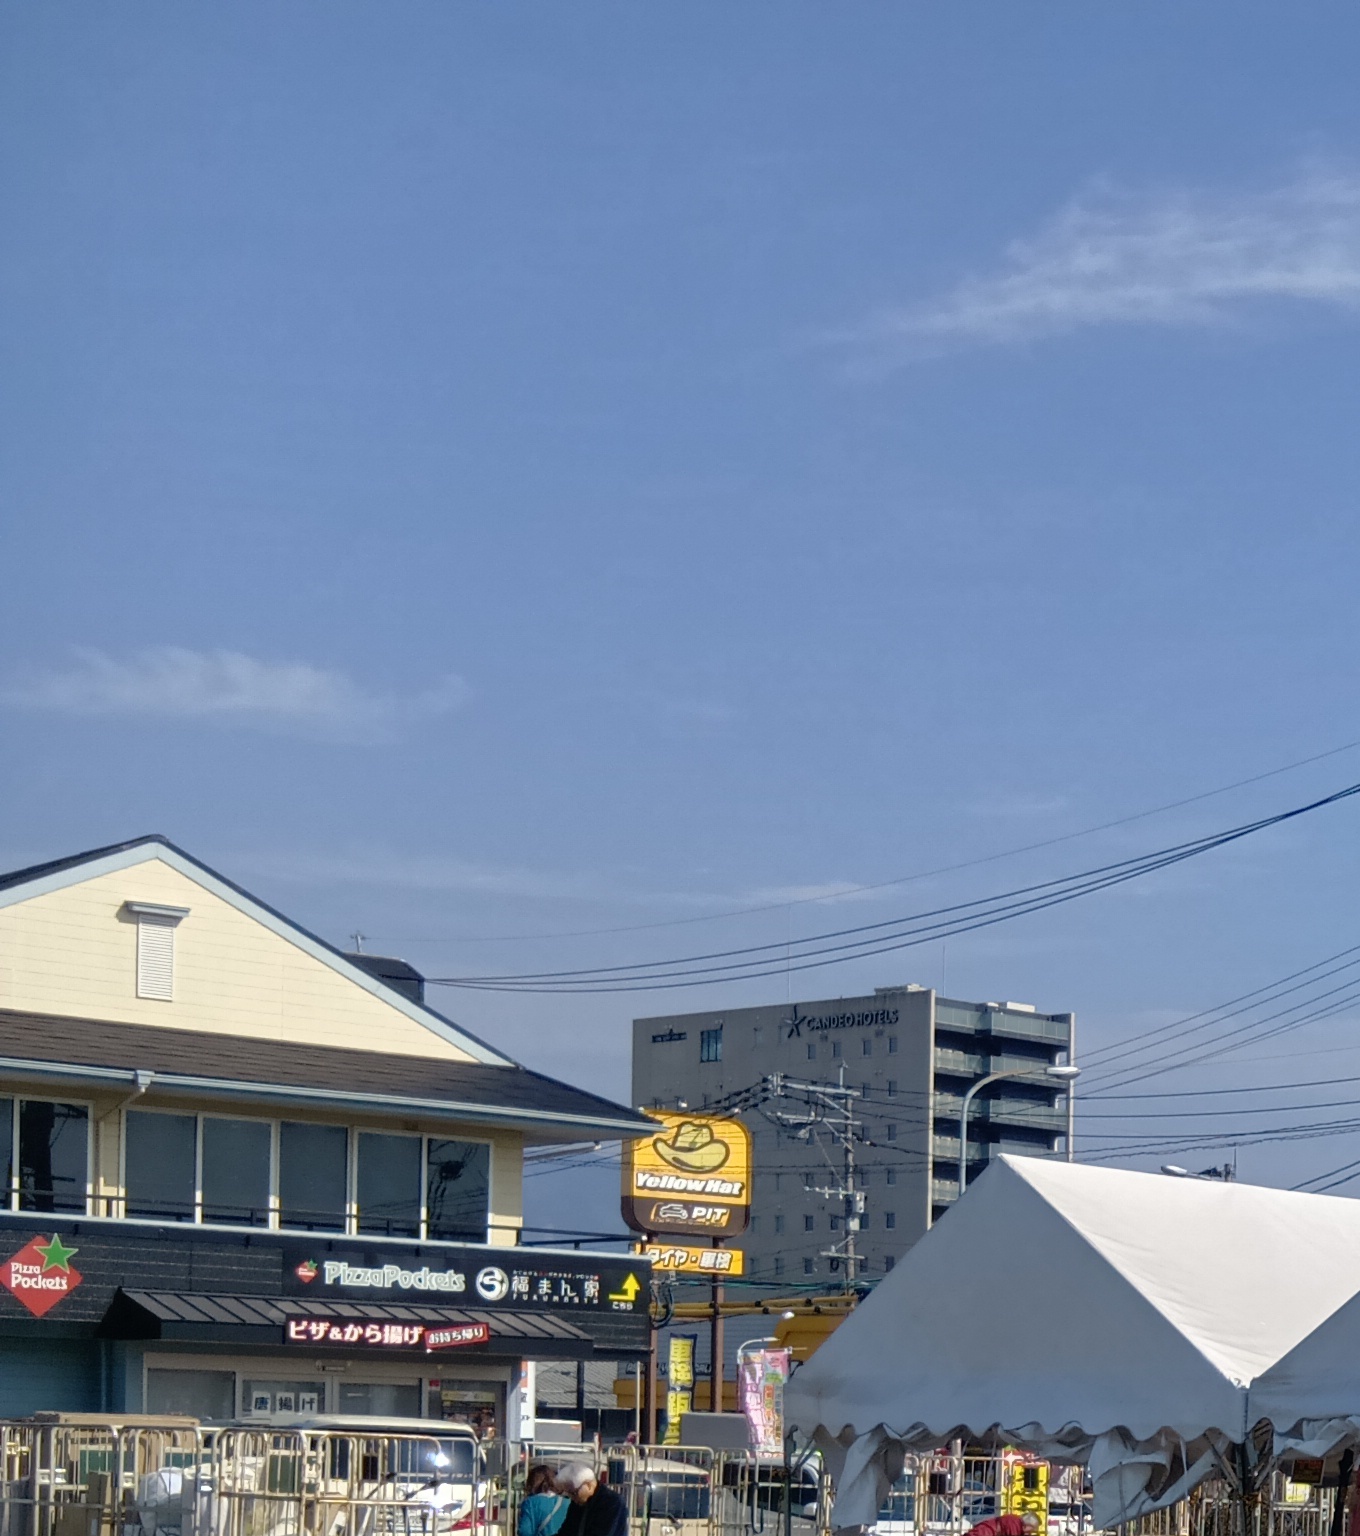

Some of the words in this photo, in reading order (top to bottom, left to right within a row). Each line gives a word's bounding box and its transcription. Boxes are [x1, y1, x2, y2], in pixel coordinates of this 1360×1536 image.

[806, 1013, 855, 1031] CANDEO
[856, 1009, 899, 1026] HOTELS
[691, 1206, 728, 1222] PIT
[11, 1262, 40, 1274] Pizza
[11, 1273, 68, 1290] Pockets
[512, 1275, 600, 1297] 福まん家
[612, 1301, 633, 1310] こちら
[254, 1396, 318, 1412] 唐揚げ
